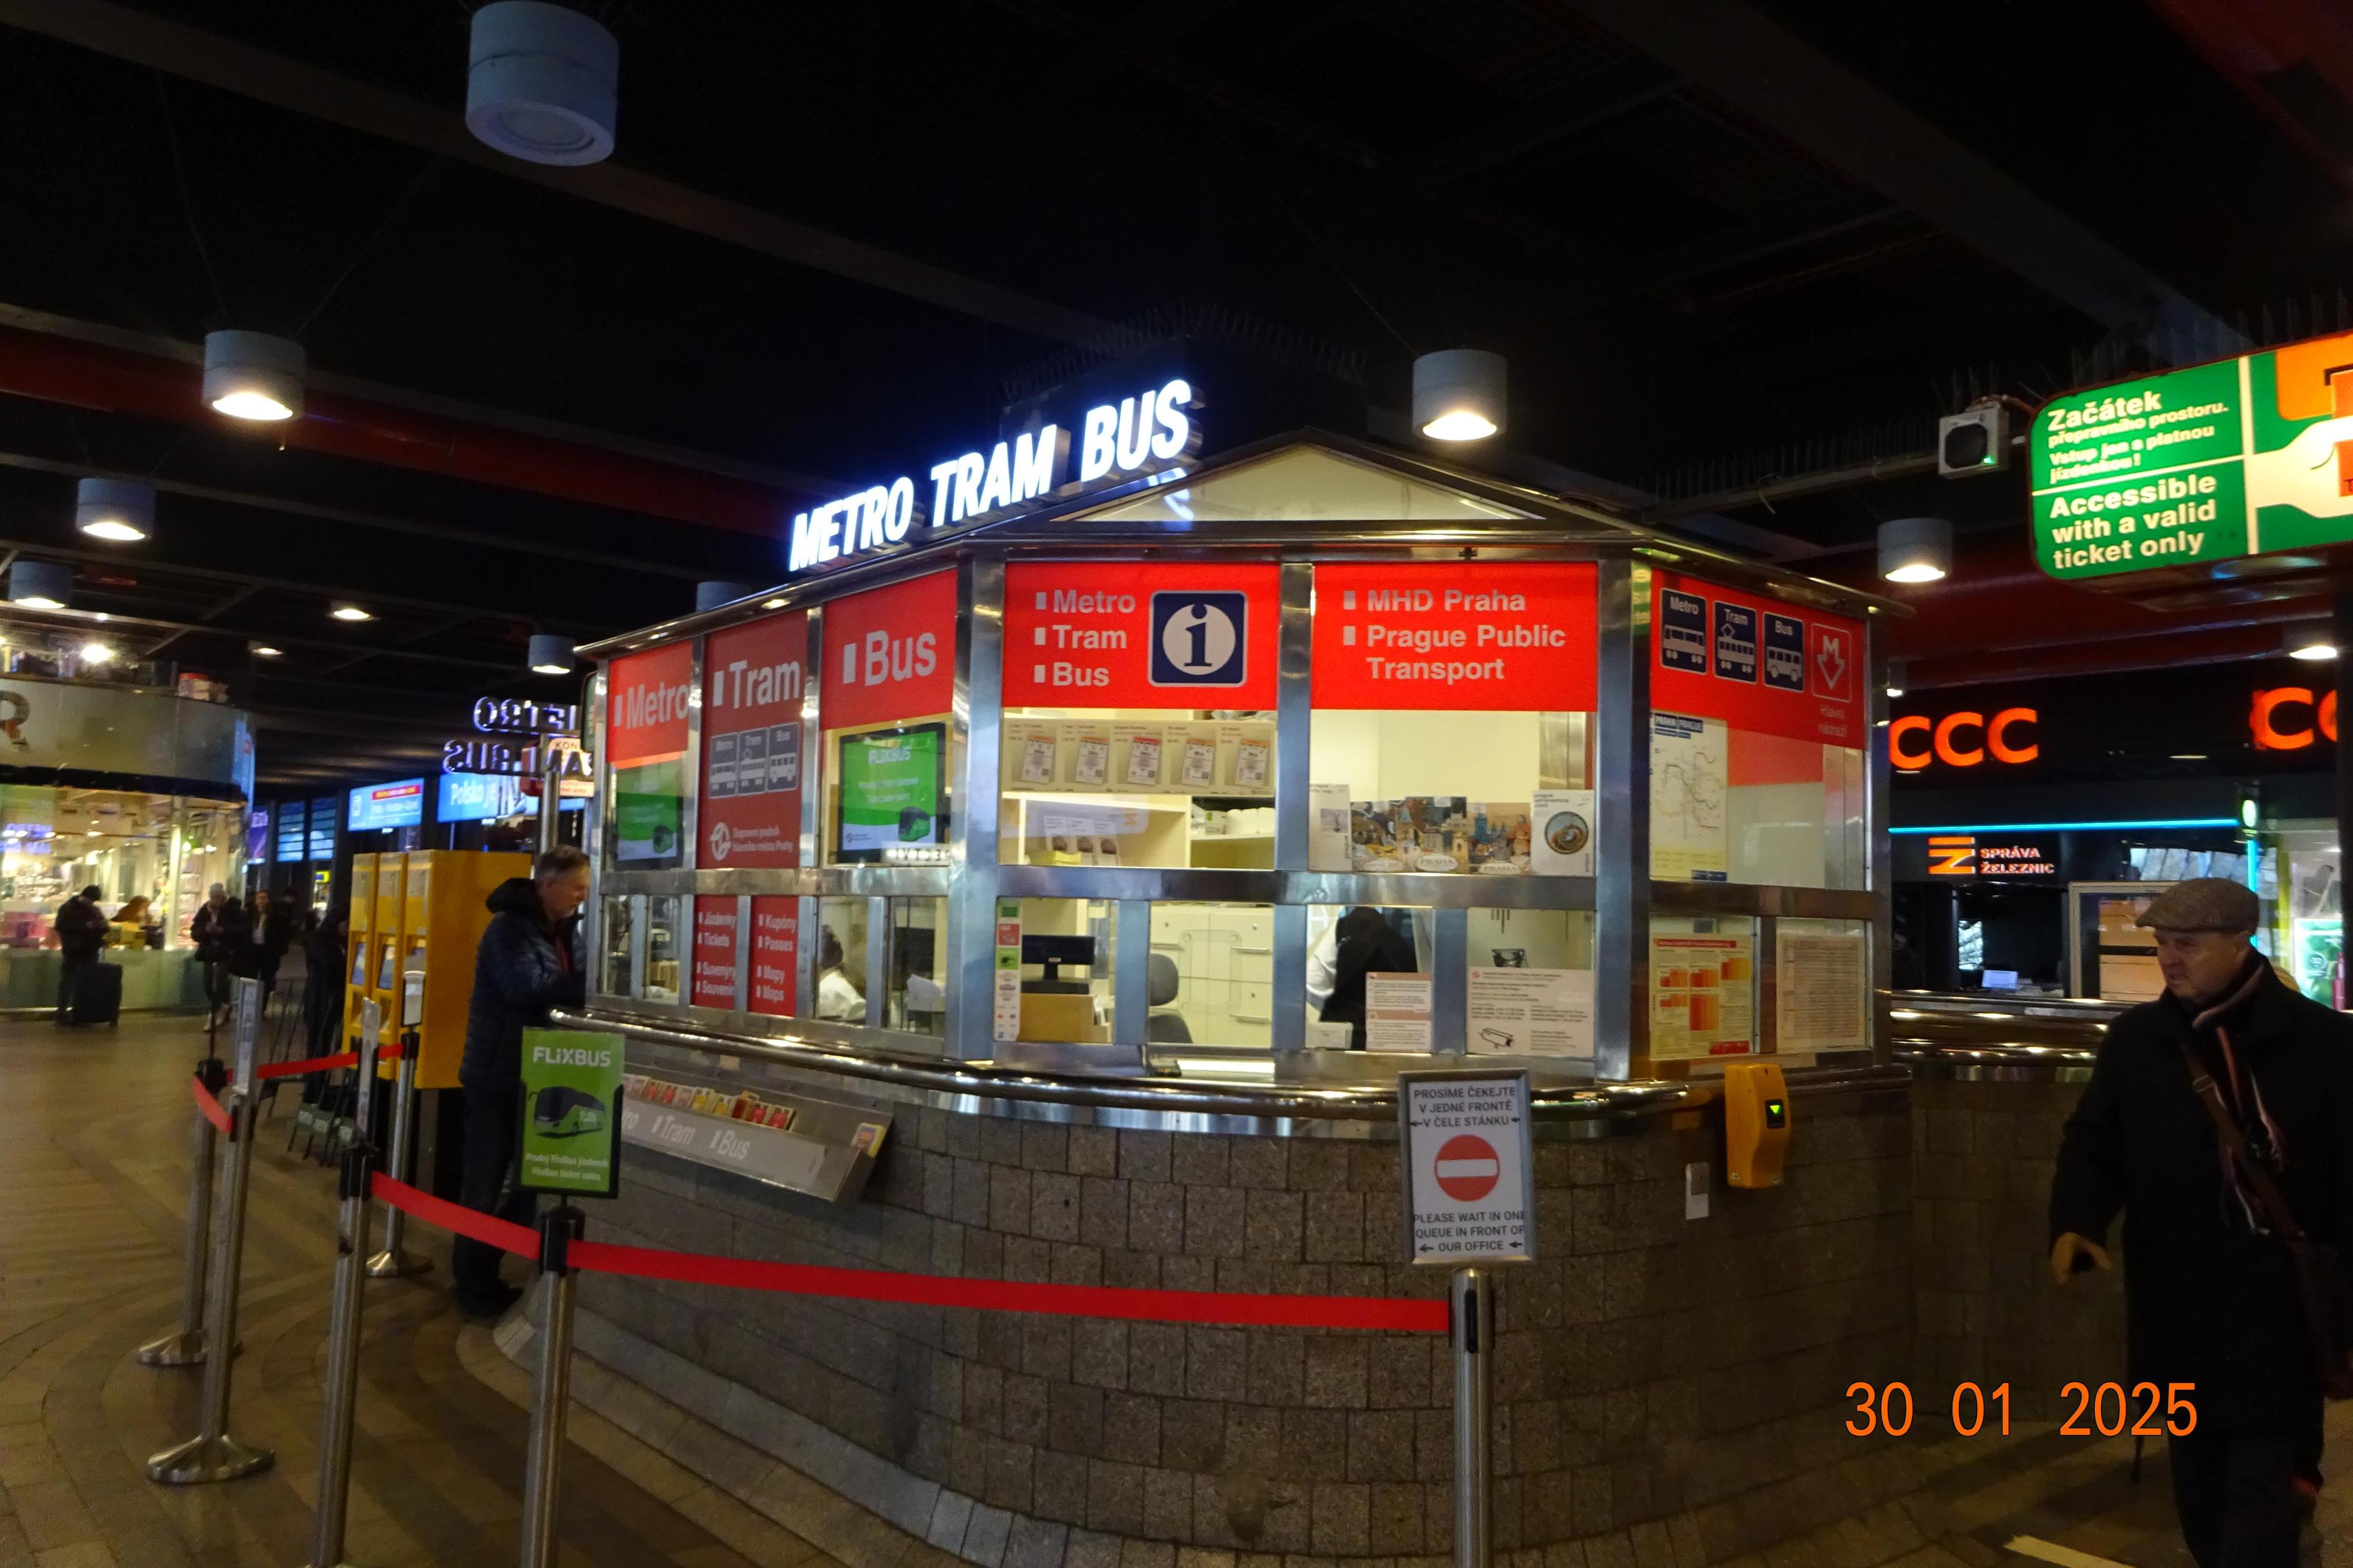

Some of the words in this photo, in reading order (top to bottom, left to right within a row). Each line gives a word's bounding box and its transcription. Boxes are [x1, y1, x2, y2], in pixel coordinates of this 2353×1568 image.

[2048, 391, 2162, 431] Začátek
[2149, 402, 2229, 429] prostoru.
[2049, 448, 2098, 465] Vstup
[2131, 439, 2144, 451] s
[2146, 426, 2215, 451] platnou
[789, 476, 915, 572] METRO
[930, 424, 1058, 528] TRAM
[1081, 378, 1193, 483] BUS
[2049, 474, 2217, 519] Accessible
[2052, 518, 2111, 543] with
[2118, 516, 2136, 534] a
[2143, 499, 2217, 529] valid
[2053, 540, 2133, 569] ticket
[2140, 531, 2205, 555] only
[1053, 589, 1136, 614] Metro
[1367, 590, 1434, 612] MHD
[1444, 589, 1527, 612] Praha
[1670, 596, 1699, 616] Metro
[1724, 608, 1748, 626] Tram
[1775, 620, 1794, 636] Bus
[1052, 625, 1127, 649] Tram
[1367, 625, 1467, 653] Prague
[1477, 624, 1567, 648] Public
[865, 629, 937, 687] Bus
[728, 659, 801, 710] Tram
[1052, 662, 1110, 687] Bus
[1366, 658, 1505, 685] Transport
[625, 681, 691, 730] Metro
[1889, 708, 2038, 769] CCC
[1979, 845, 2041, 859] SPRÁVA
[1979, 861, 2055, 874] ŽELEZNIC
[1414, 1088, 1464, 1099] PROSÍME
[1468, 1086, 1516, 1097] ČEKEJTE
[1419, 1103, 1427, 1113] V
[1468, 1100, 1512, 1112] FRONTĚ
[659, 1115, 696, 1146] Tram
[1423, 1119, 1430, 1128] V
[1434, 1116, 1461, 1127] ČELE
[1464, 1116, 1509, 1126] STÁNKU
[716, 1129, 752, 1160] Bus
[1414, 1212, 1455, 1224] PLEASE
[1458, 1212, 1485, 1222] WAIT
[1489, 1212, 1501, 1221] IN
[1504, 1210, 1525, 1220] ONE
[1415, 1227, 1452, 1239] QUEUE
[1455, 1227, 1467, 1236] IN
[1471, 1226, 1507, 1236] FRONT
[1511, 1224, 1525, 1235] OF
[1438, 1241, 1461, 1252] OUR
[1465, 1240, 1504, 1251] OFFICE
